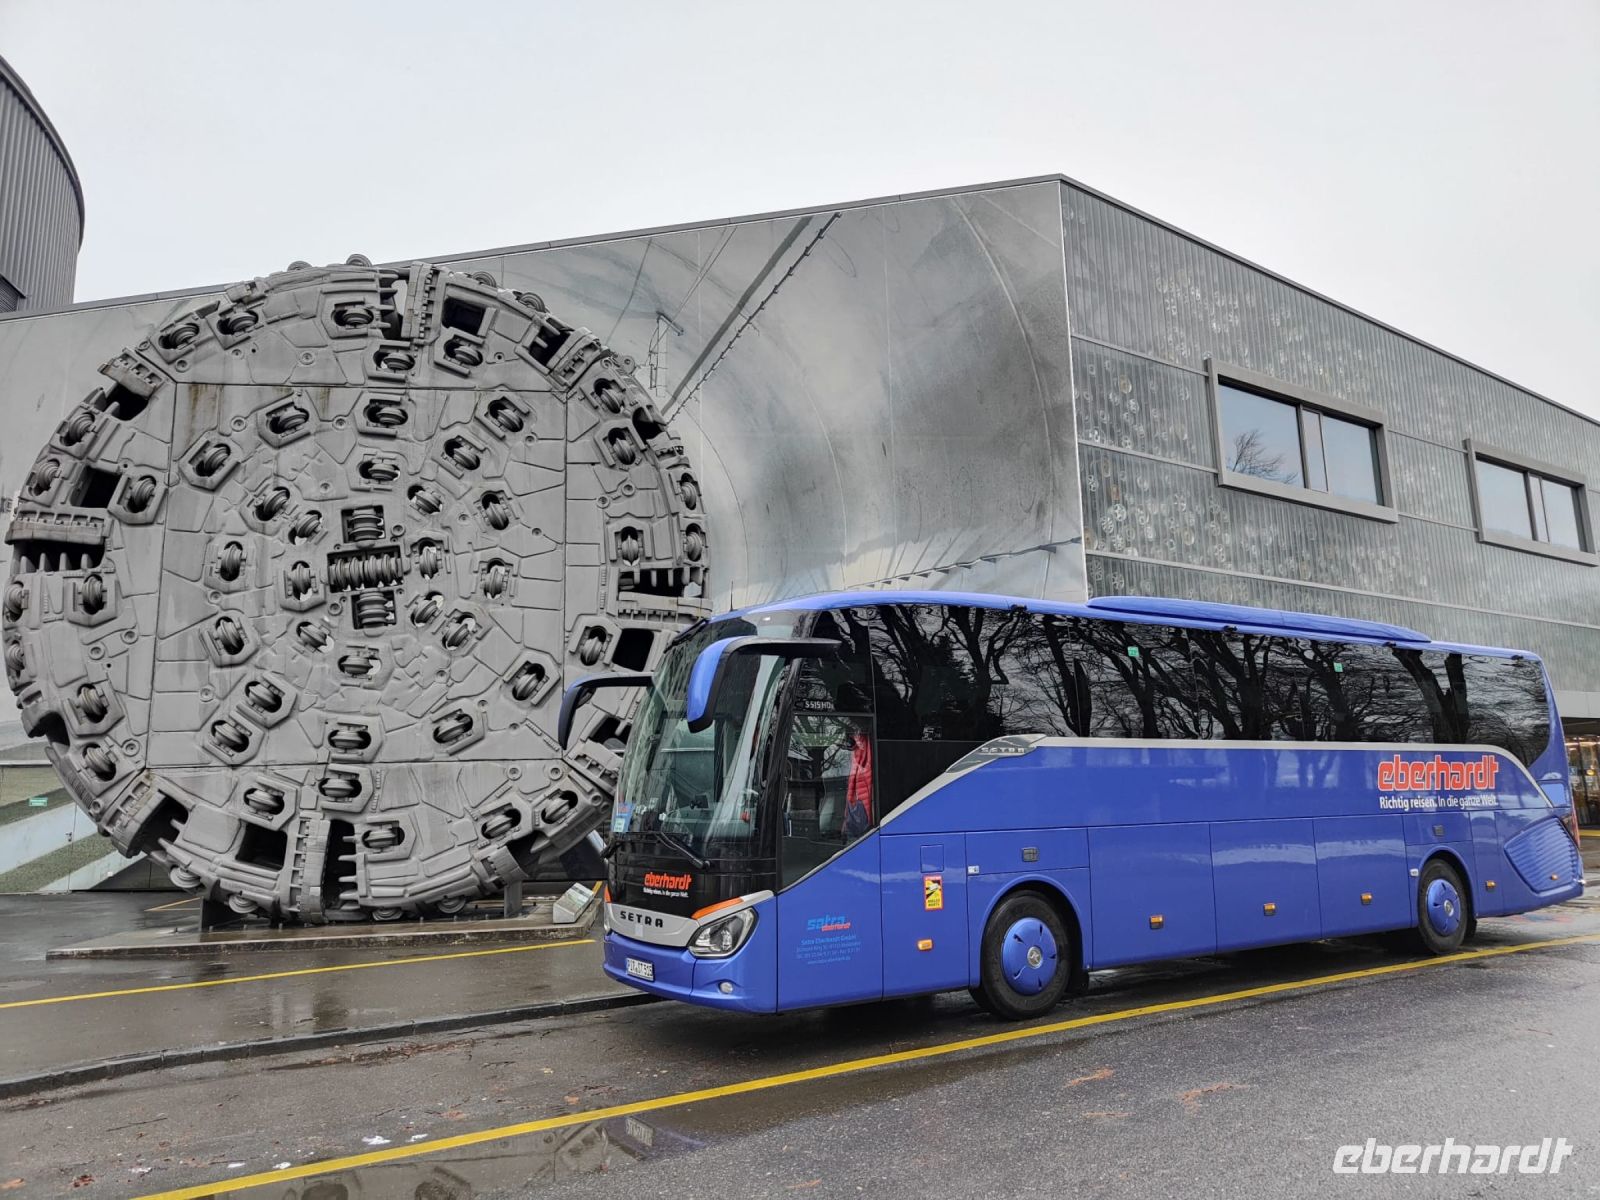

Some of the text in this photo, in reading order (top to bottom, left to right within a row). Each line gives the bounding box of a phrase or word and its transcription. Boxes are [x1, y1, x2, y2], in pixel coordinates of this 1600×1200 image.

[1378, 754, 1499, 791] eberhardt
[1380, 795, 1409, 811] Richtig
[1410, 796, 1437, 808] reisen.
[1438, 796, 1446, 807] In
[1447, 795, 1459, 807] die
[1459, 797, 1481, 810] ganze
[645, 872, 692, 890] eberhardt
[620, 910, 664, 928] SETRA
